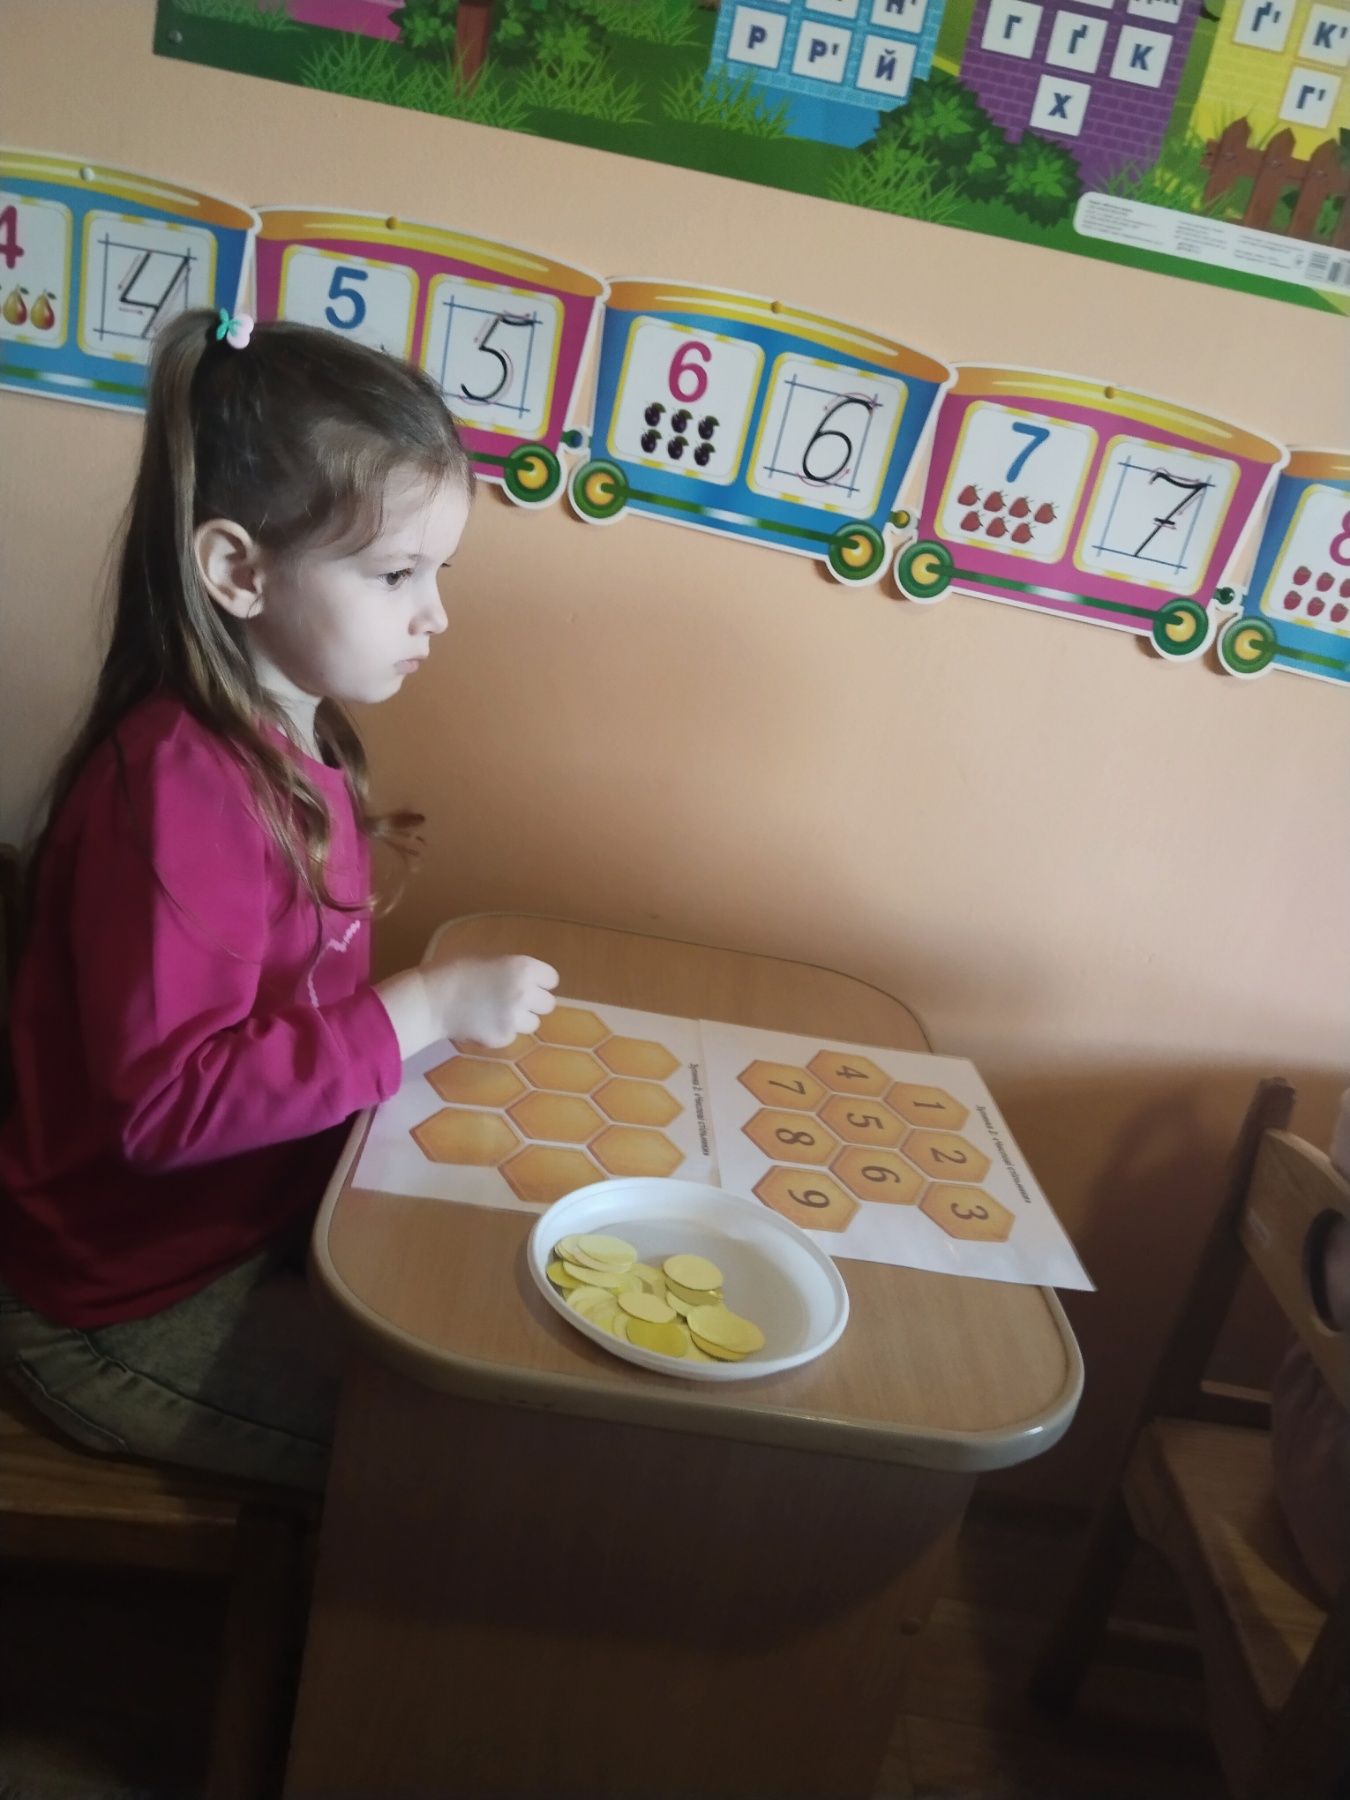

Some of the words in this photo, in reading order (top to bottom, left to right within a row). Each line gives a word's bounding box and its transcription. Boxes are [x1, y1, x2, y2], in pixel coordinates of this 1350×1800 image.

[748, 24, 767, 49] Р
[1003, 14, 1022, 39] Г
[875, 49, 897, 81] Й
[1130, 43, 1154, 71] К
[1048, 92, 1073, 119] Х
[325, 266, 367, 330] 5
[461, 312, 536, 401] 5
[667, 340, 712, 403] 6
[802, 398, 875, 482] 6
[1005, 421, 1051, 484] 7
[1134, 469, 1207, 556] 7
[836, 1065, 869, 1080] 4
[768, 1080, 806, 1095] 7
[913, 1101, 946, 1110] 1
[846, 1112, 884, 1130] 5
[775, 1128, 815, 1146] 8
[930, 1147, 967, 1164] 2
[861, 1165, 900, 1184] 6
[788, 1189, 830, 1209] 9
[951, 1203, 989, 1221] 3
